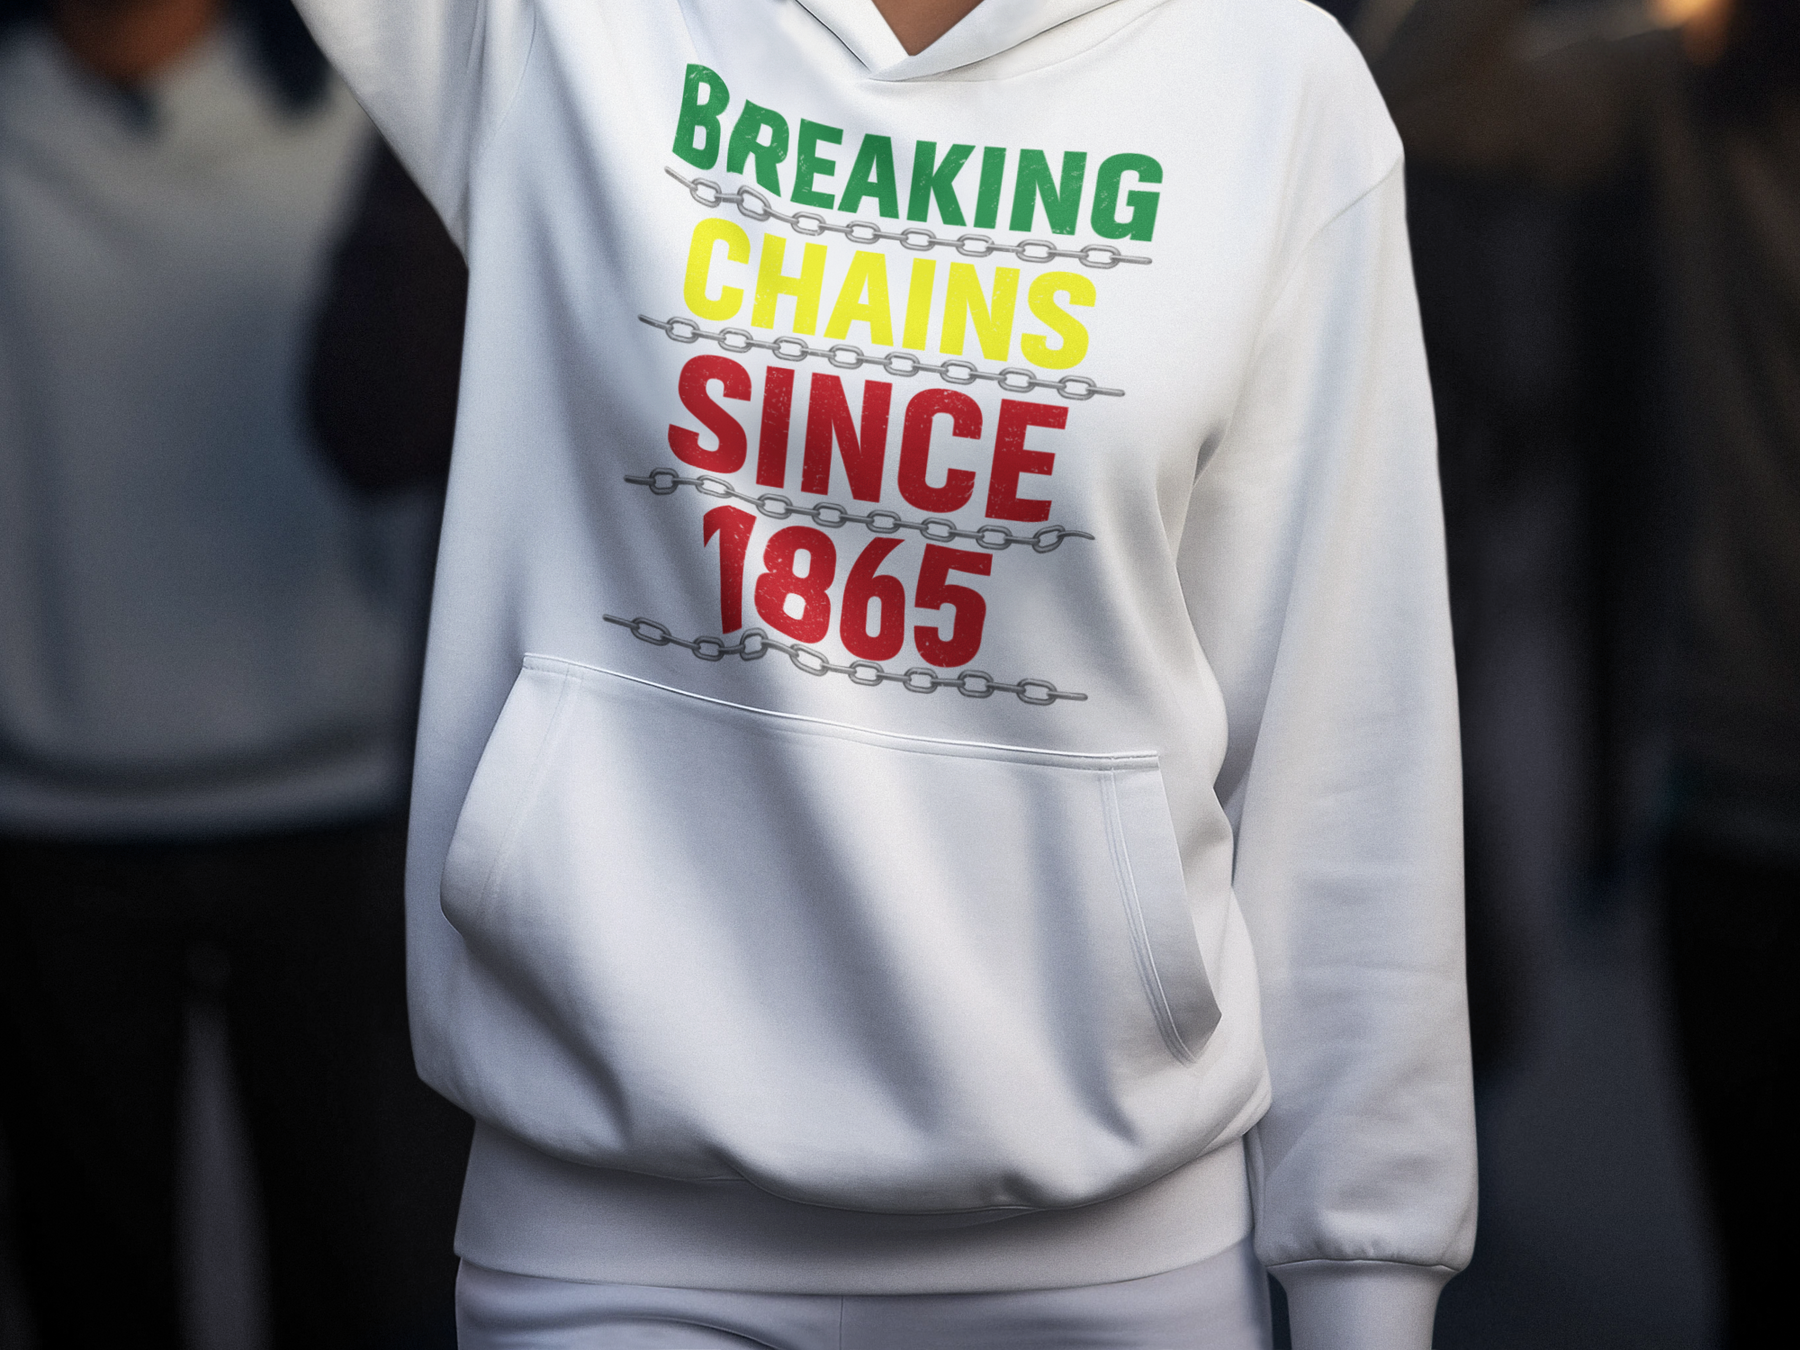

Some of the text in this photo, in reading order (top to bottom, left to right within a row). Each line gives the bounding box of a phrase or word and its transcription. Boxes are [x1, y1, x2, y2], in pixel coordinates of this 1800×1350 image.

[673, 64, 1162, 241] BREAKING
[684, 218, 1096, 369] CHAINS
[668, 355, 1068, 522] SINCE
[704, 506, 992, 667] 1865
